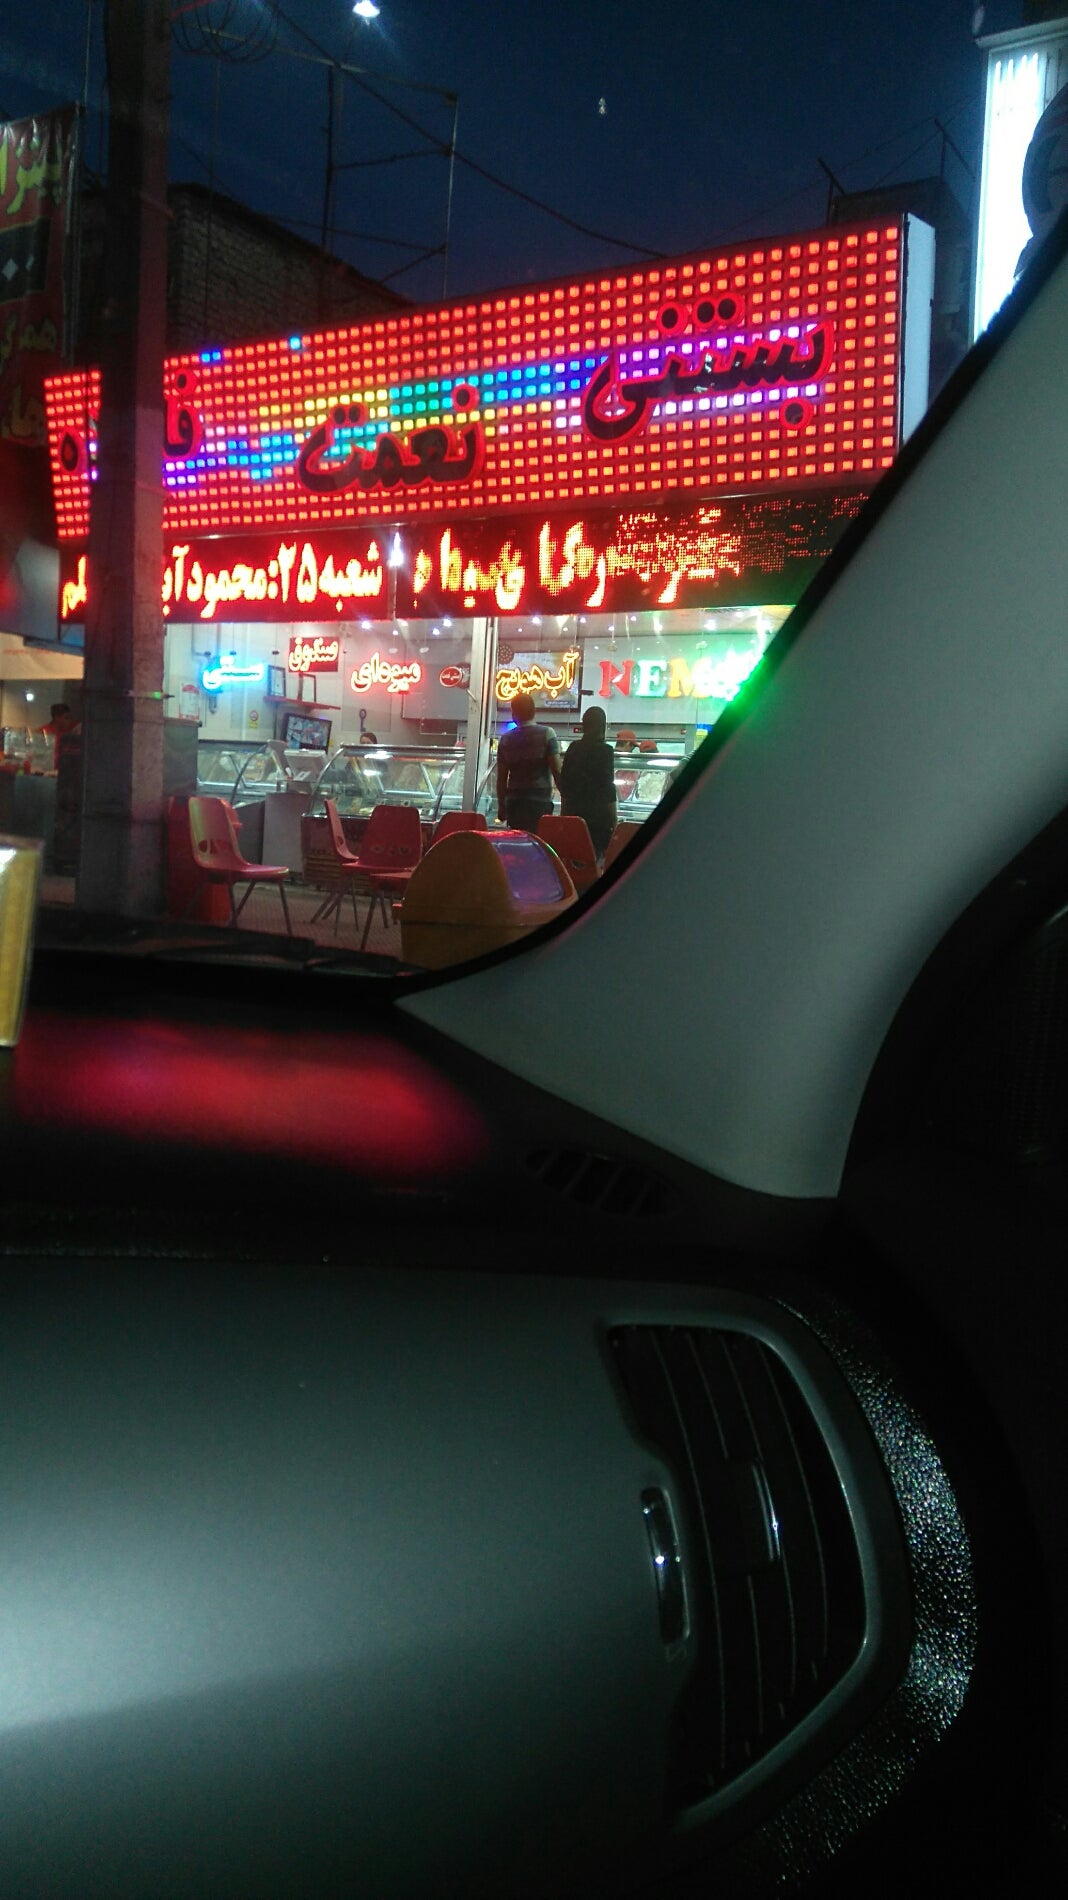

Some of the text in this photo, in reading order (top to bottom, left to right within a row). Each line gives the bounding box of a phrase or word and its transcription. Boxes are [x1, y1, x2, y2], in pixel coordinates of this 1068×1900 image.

[583, 294, 835, 444] بستنی
[300, 383, 484, 495] نعمت
[318, 539, 384, 612] شعبه
[544, 651, 580, 699] آب
